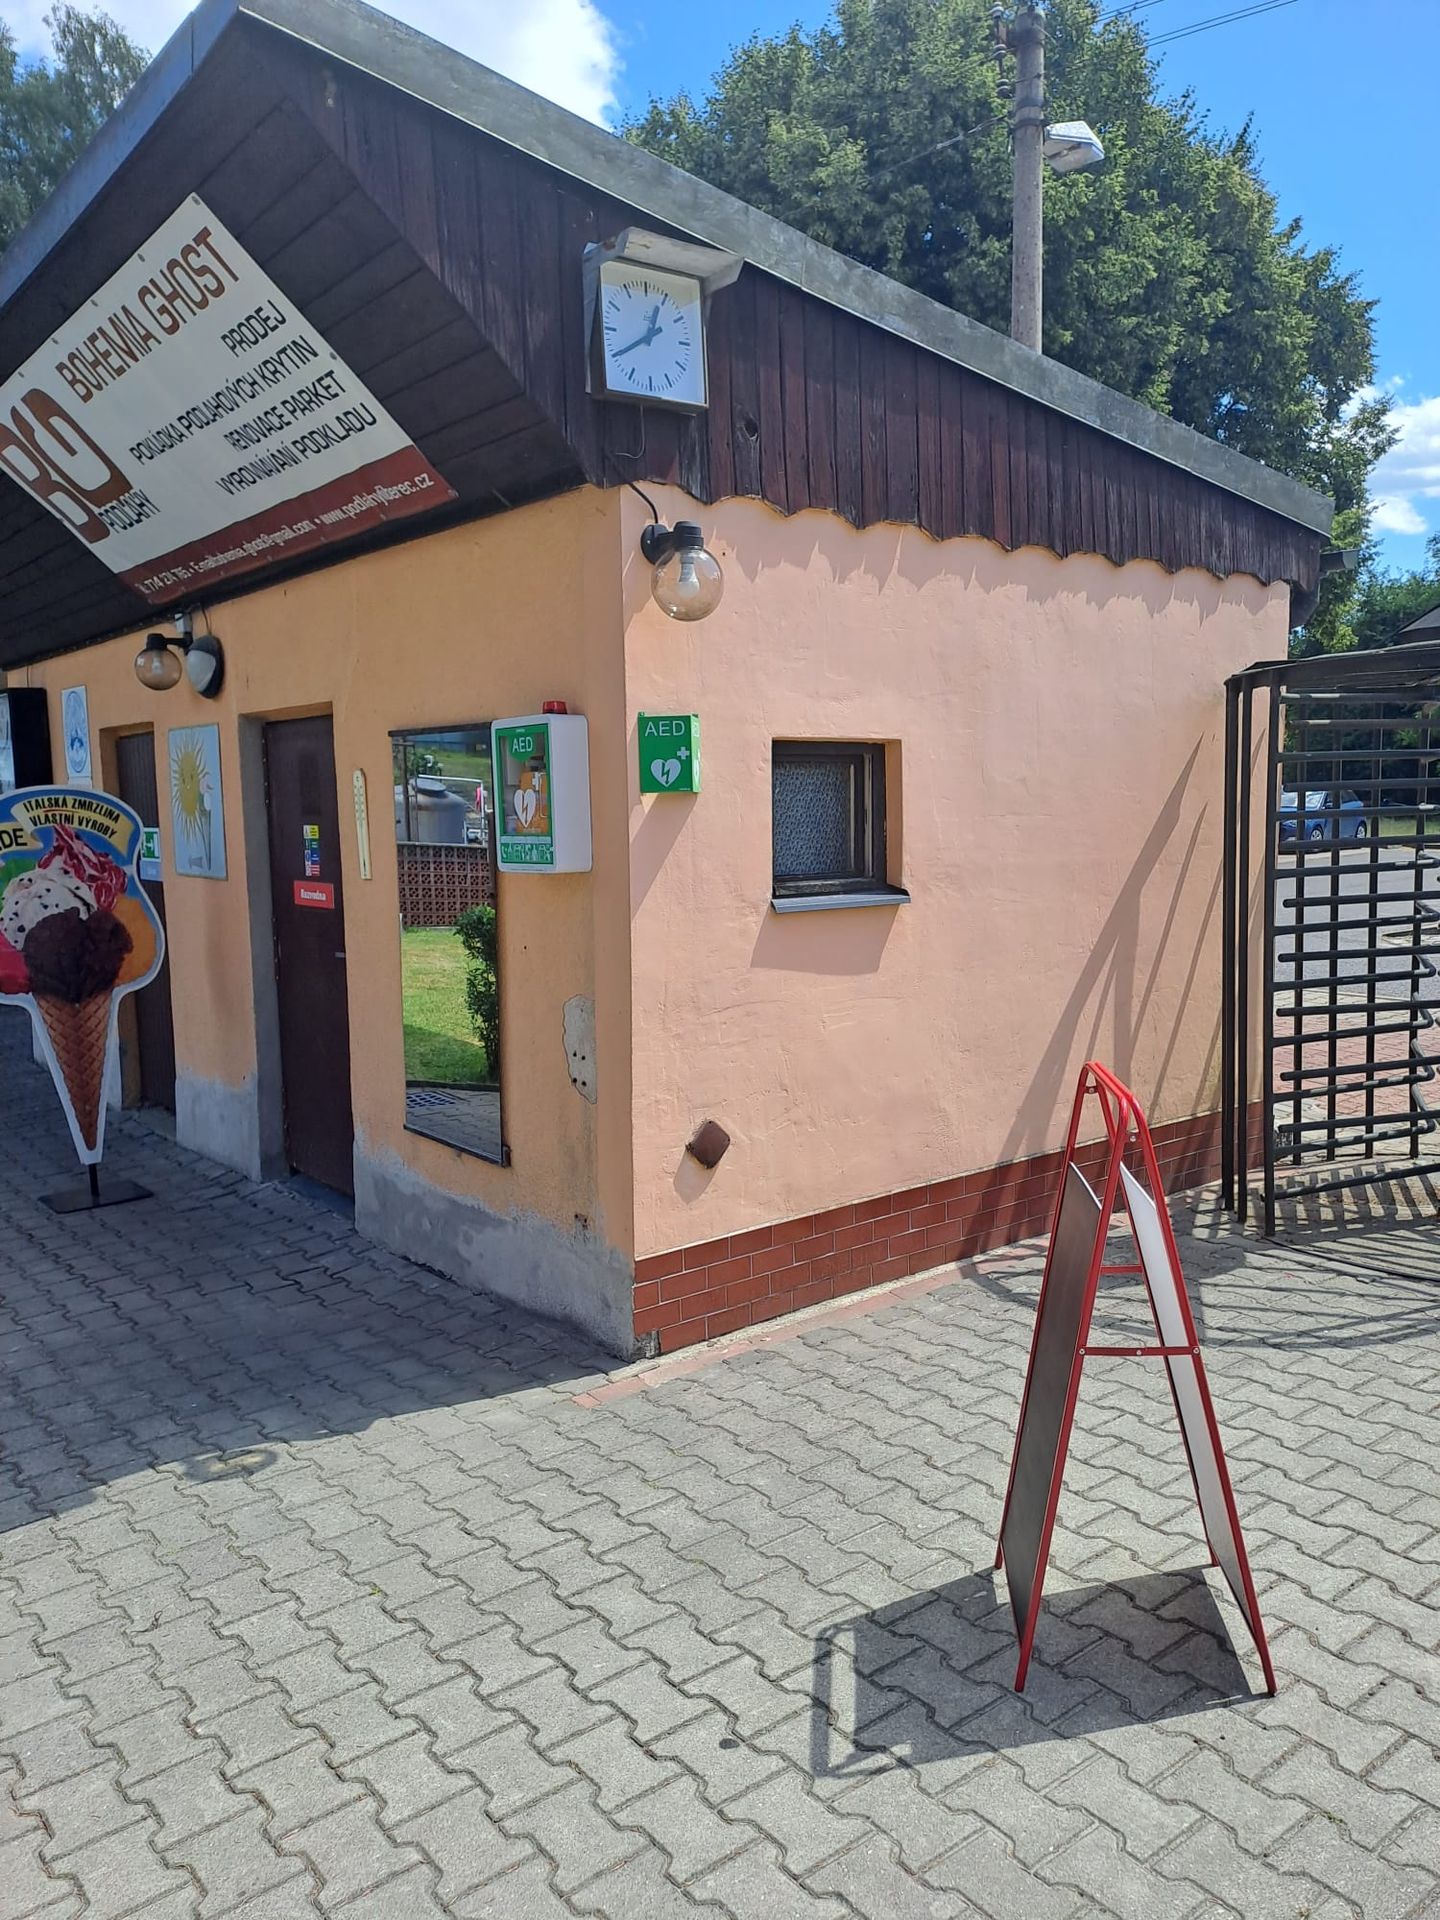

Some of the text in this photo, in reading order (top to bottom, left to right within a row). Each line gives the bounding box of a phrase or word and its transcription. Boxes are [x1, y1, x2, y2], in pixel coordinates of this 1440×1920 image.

[55, 226, 240, 404] BOHEMIA GHOST
[220, 299, 287, 358] PRODEJ
[129, 334, 320, 466] POKLÁDKA PODLAHOVÝCH KRYTIN
[223, 369, 347, 453] RENOVACE PARKET
[215, 402, 377, 496] VYROVNÁVÁNÍ PODKLADU
[98, 488, 161, 534] PODLAHY
[512, 736, 533, 753] AED
[645, 720, 685, 737] AED
[23, 796, 121, 824] ITALSKÁ ZMRZLINA
[29, 813, 74, 827] VLASTNÍ
[0, 828, 28, 850] DE
